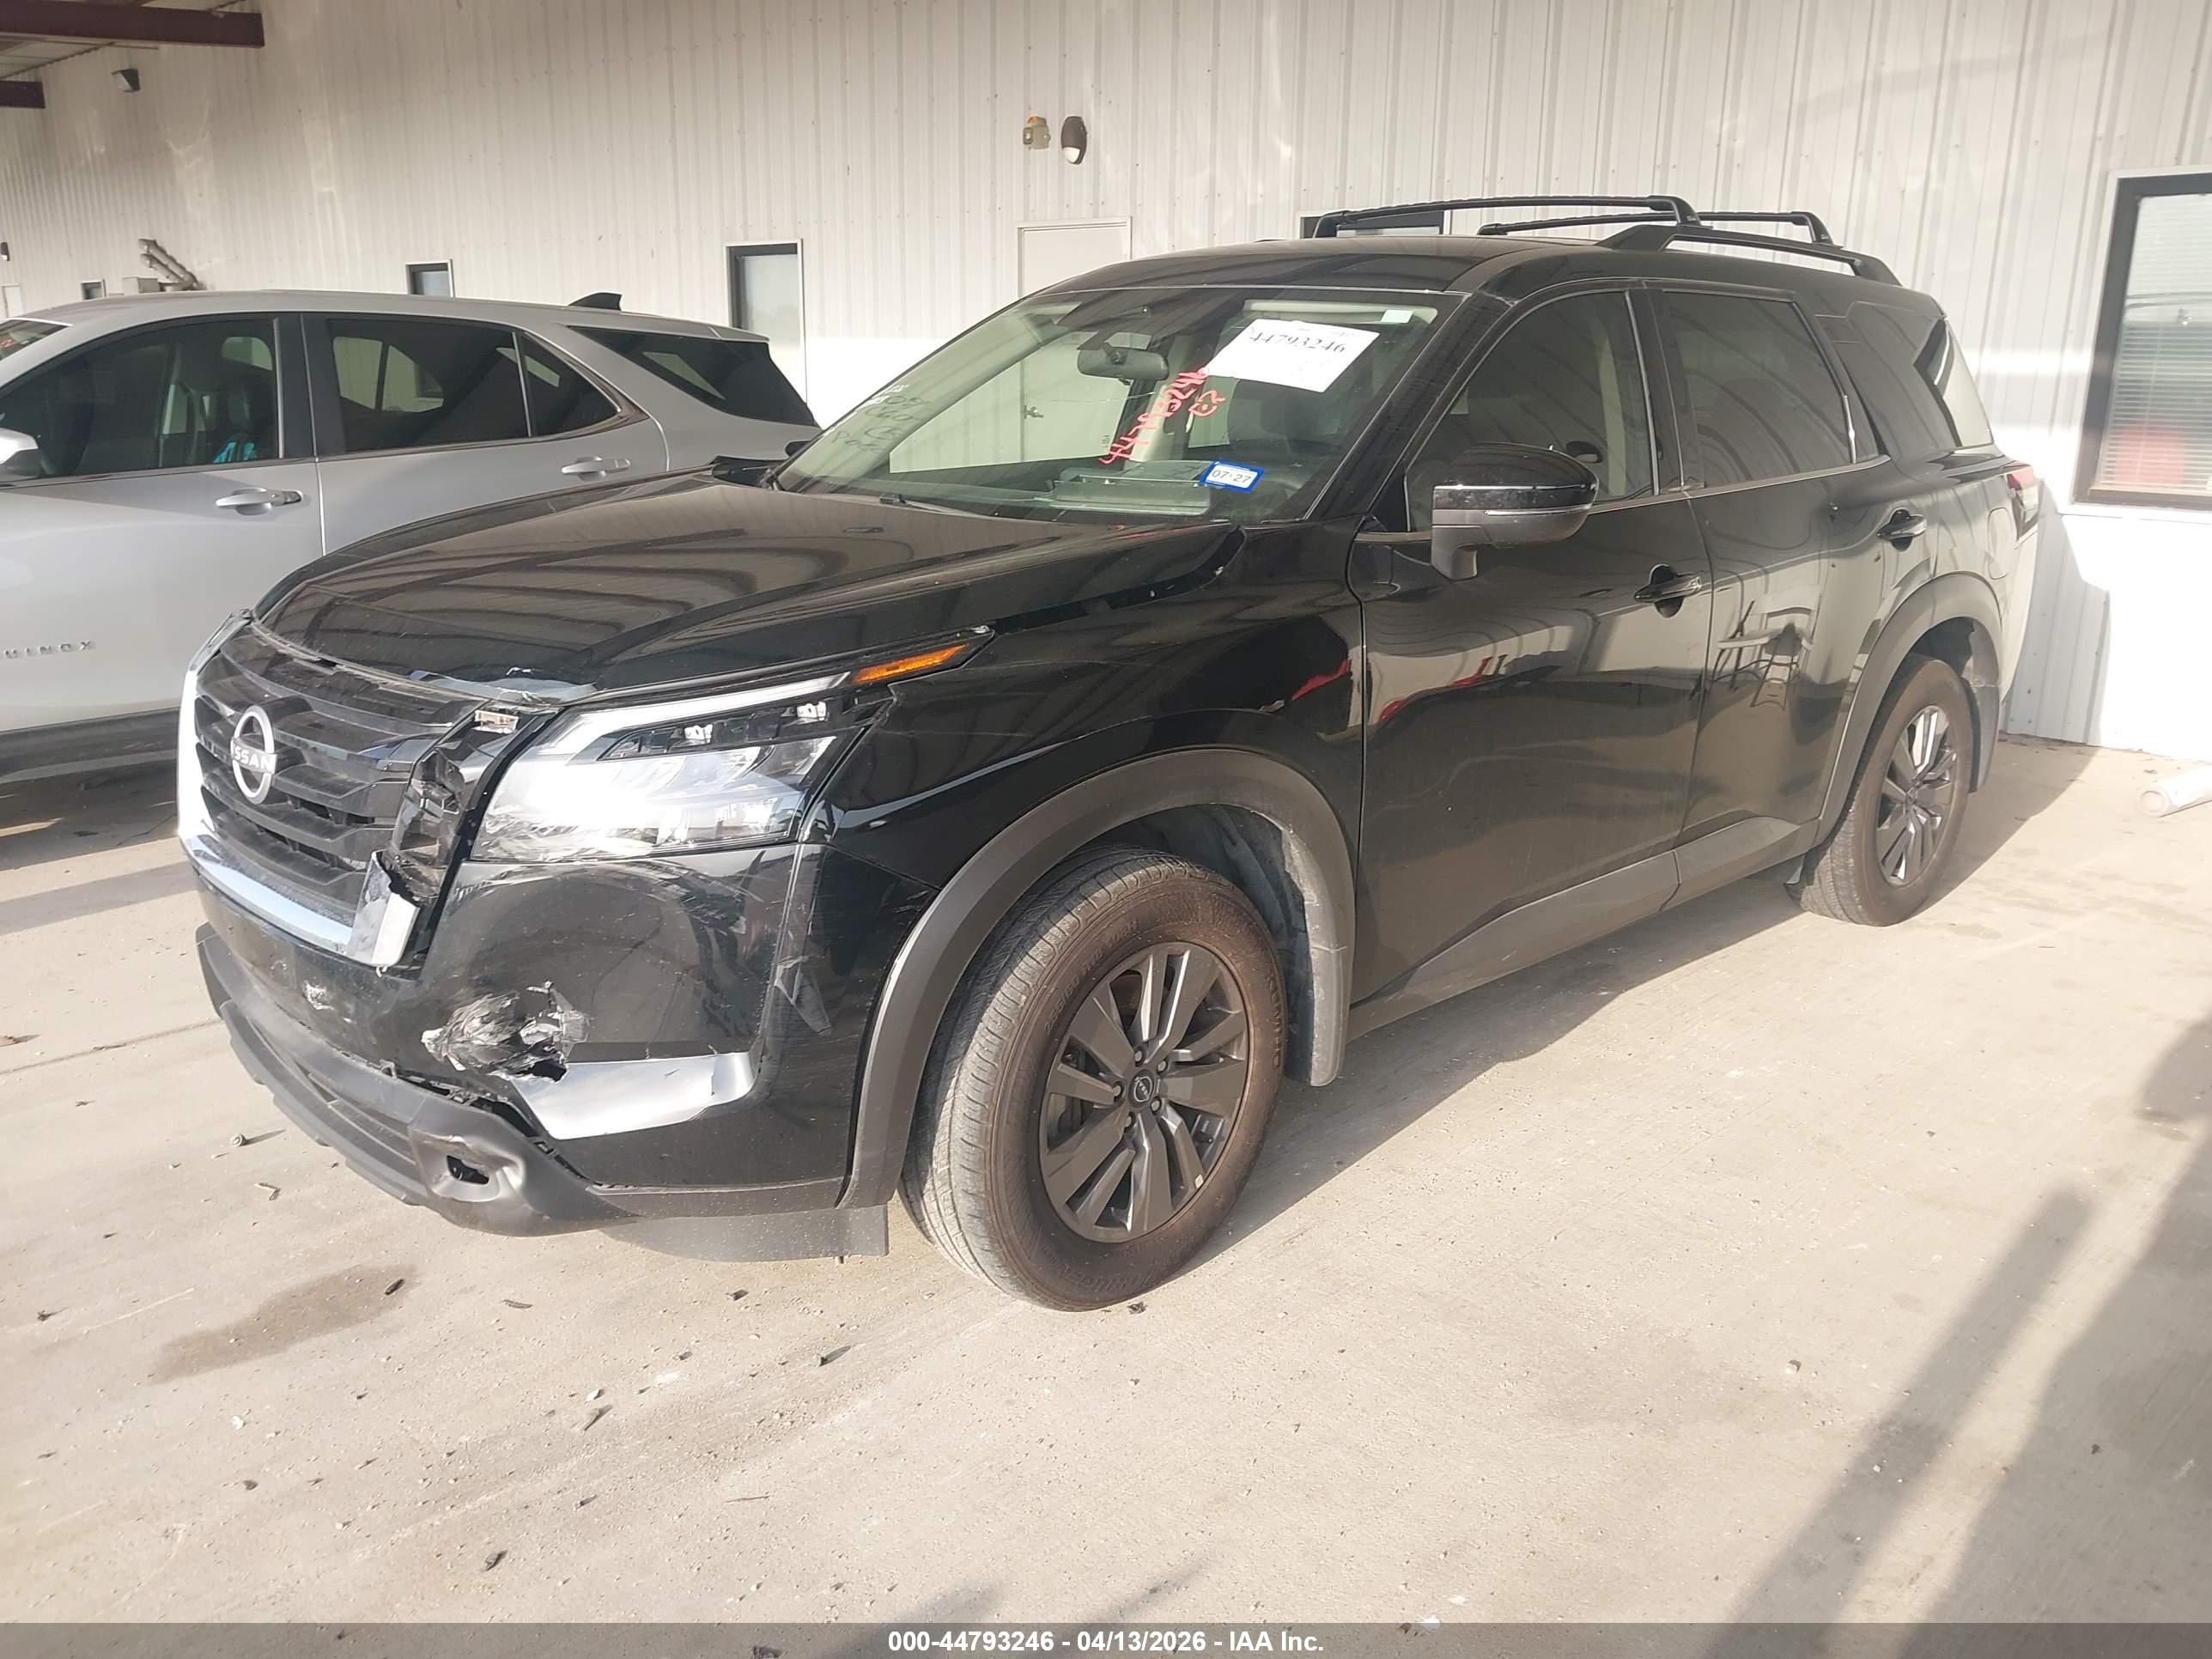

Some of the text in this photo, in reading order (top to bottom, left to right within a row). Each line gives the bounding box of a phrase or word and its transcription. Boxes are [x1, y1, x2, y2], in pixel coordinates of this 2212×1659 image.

[1249, 331, 1346, 354] 44793246
[0, 639, 92, 659] UINOX
[230, 745, 276, 774] SSAN
